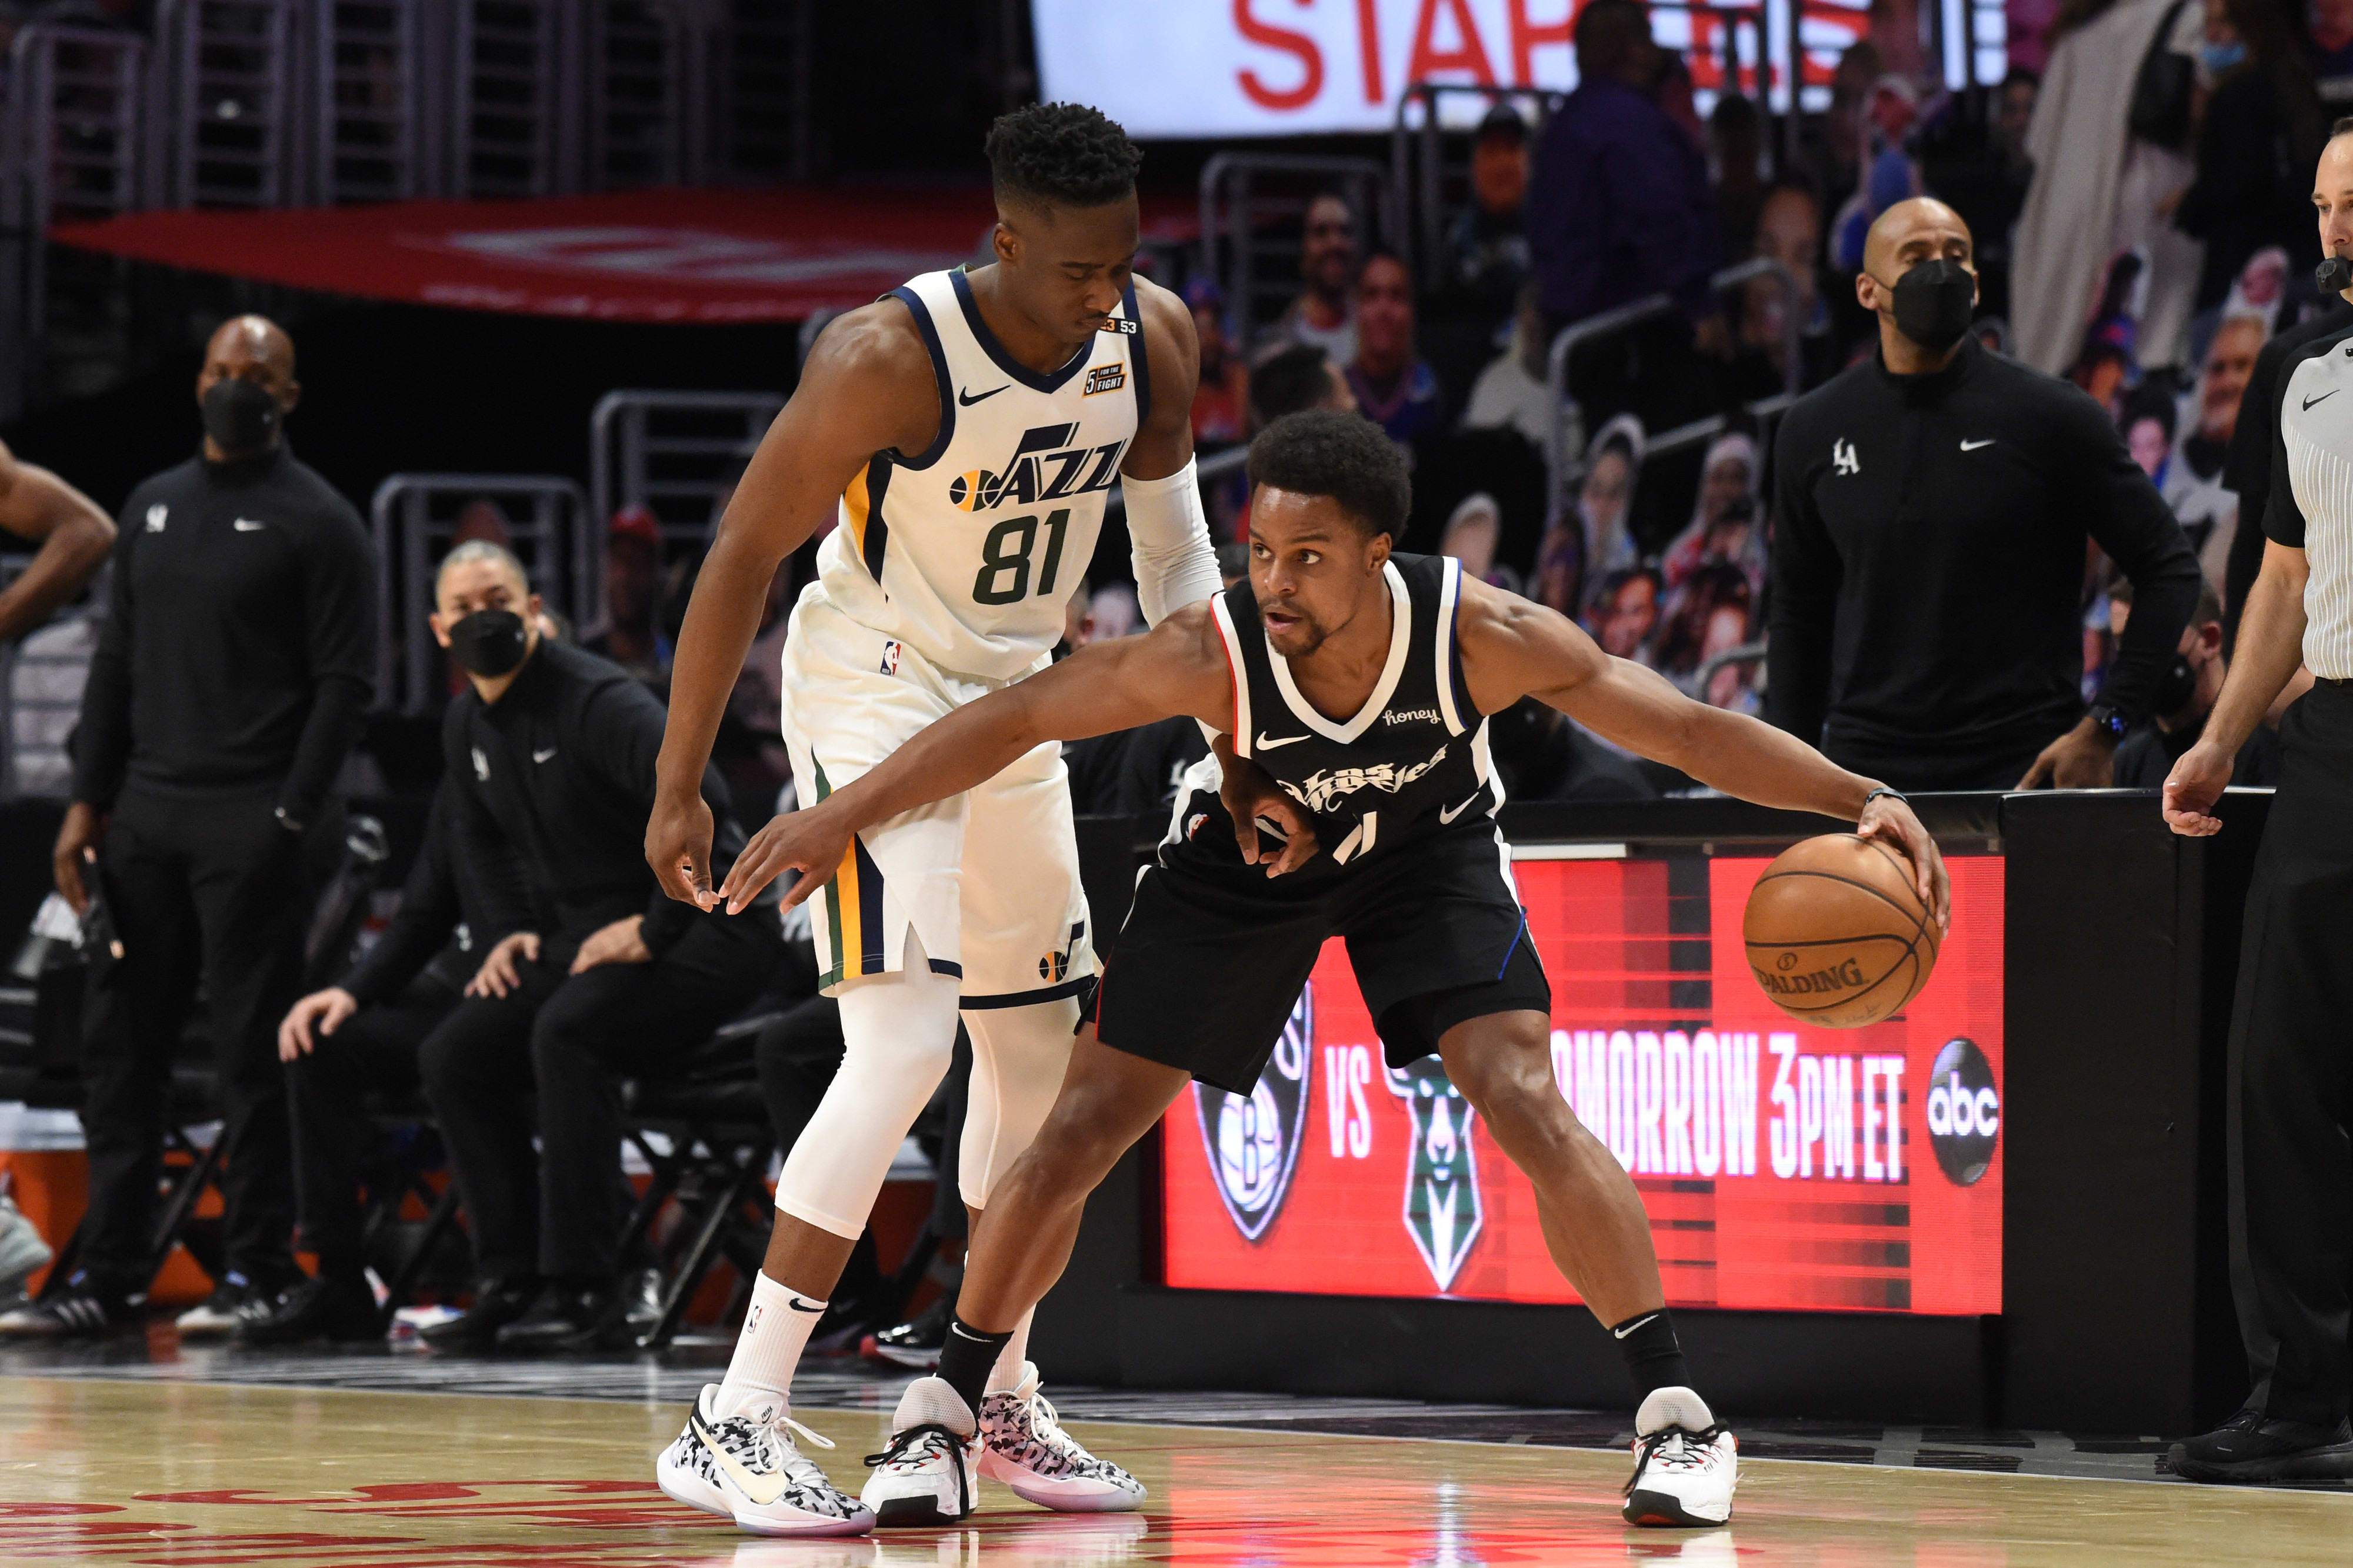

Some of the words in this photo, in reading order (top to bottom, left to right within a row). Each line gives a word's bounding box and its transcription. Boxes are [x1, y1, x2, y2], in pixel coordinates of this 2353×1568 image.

[1120, 321, 1136, 334] 53
[1086, 372, 1096, 393] 5
[1097, 377, 1122, 391] FIGHT
[972, 508, 1071, 605] 81
[1383, 708, 1441, 726] honey
[1325, 1045, 1371, 1159] VS
[1549, 1029, 1758, 1177] OMORROW
[1861, 1055, 1905, 1182] ET
[1927, 1070, 1999, 1137] abc
